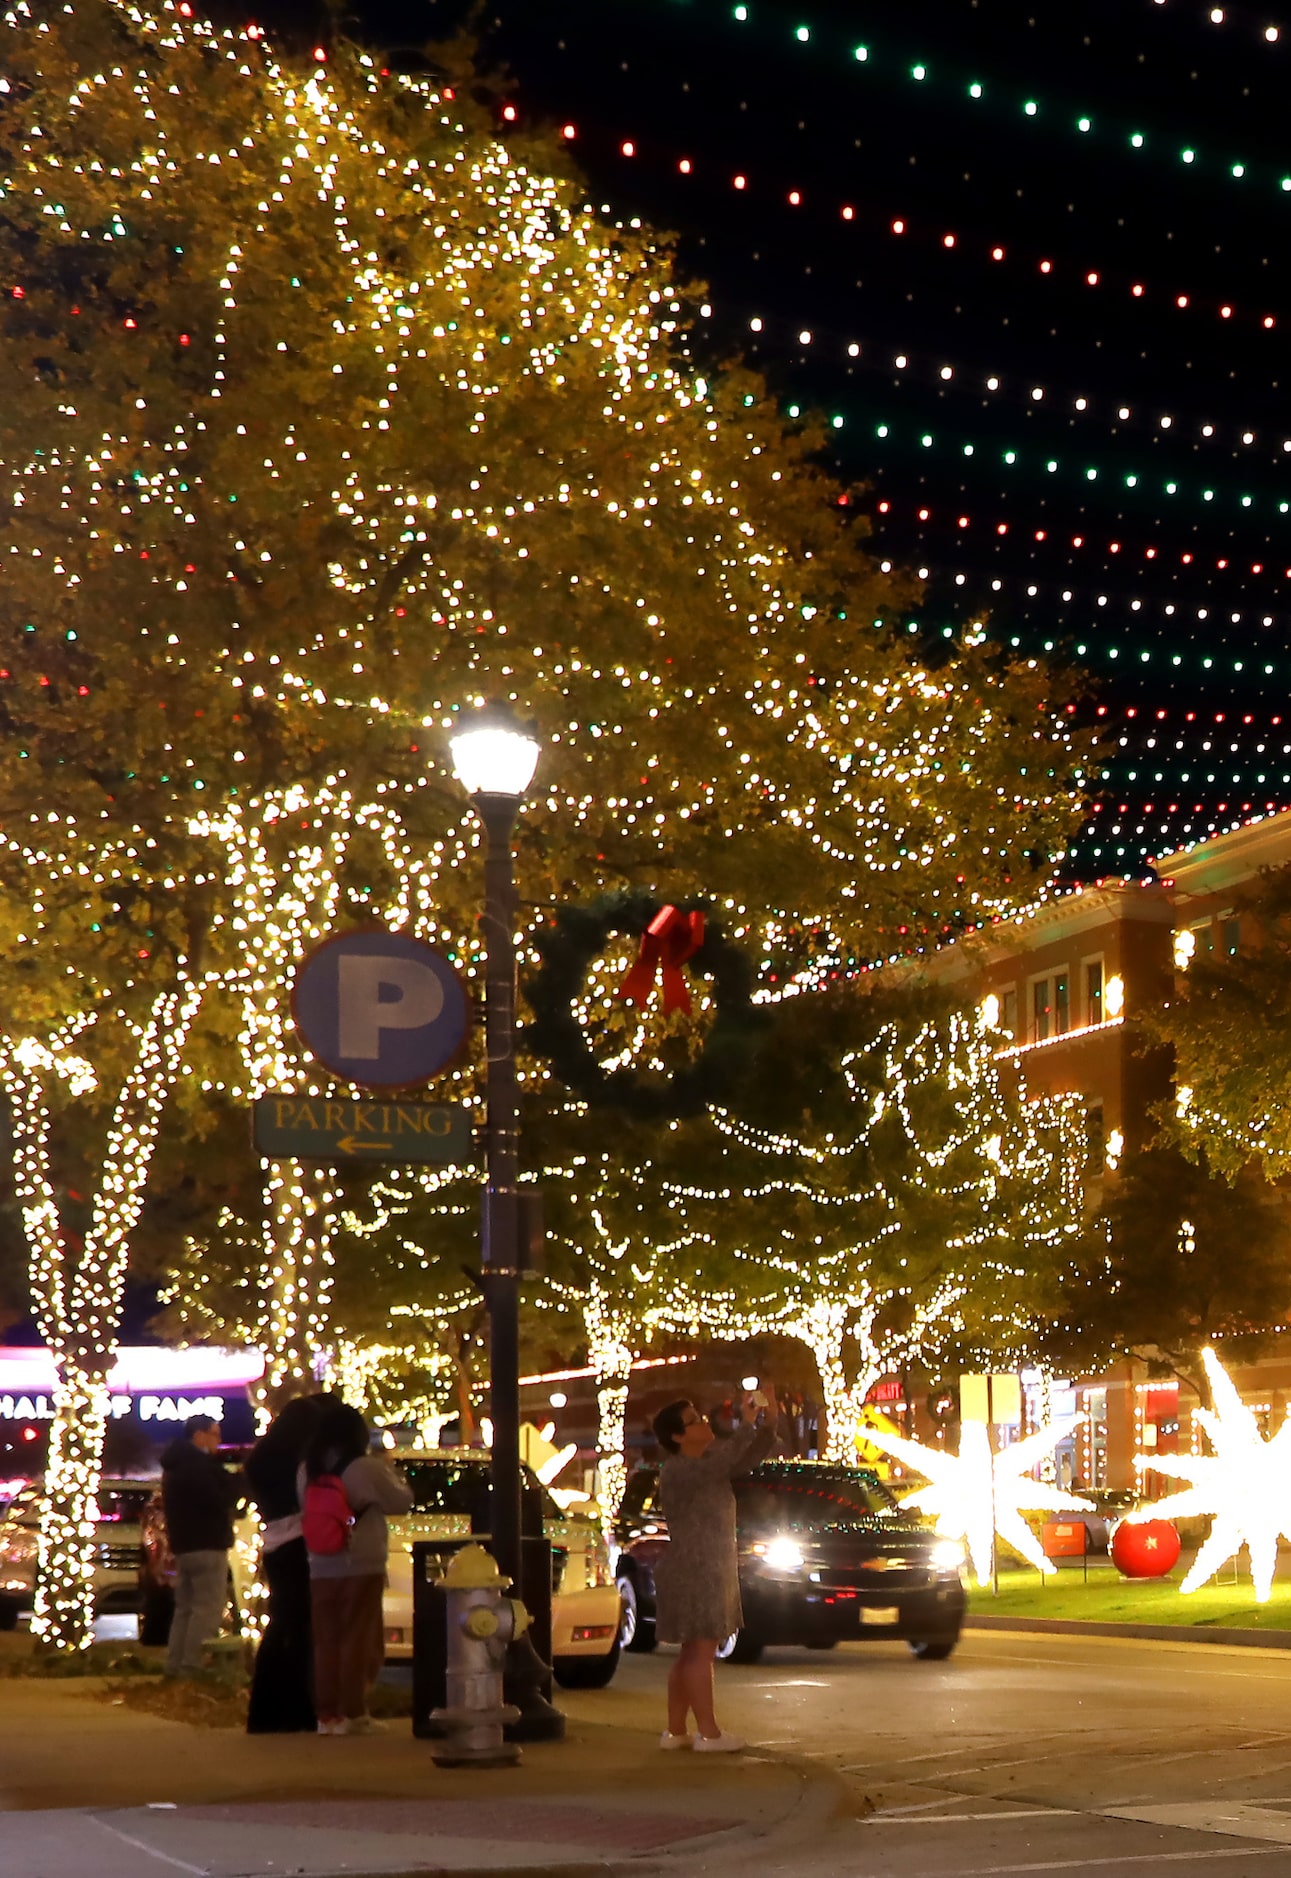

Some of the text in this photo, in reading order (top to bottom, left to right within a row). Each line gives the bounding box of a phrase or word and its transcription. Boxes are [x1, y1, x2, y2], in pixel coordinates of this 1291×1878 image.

[338, 954, 444, 1060] P
[275, 1101, 451, 1136] PARKING
[0, 1394, 57, 1420] HAL
[138, 1395, 225, 1421] FAME
